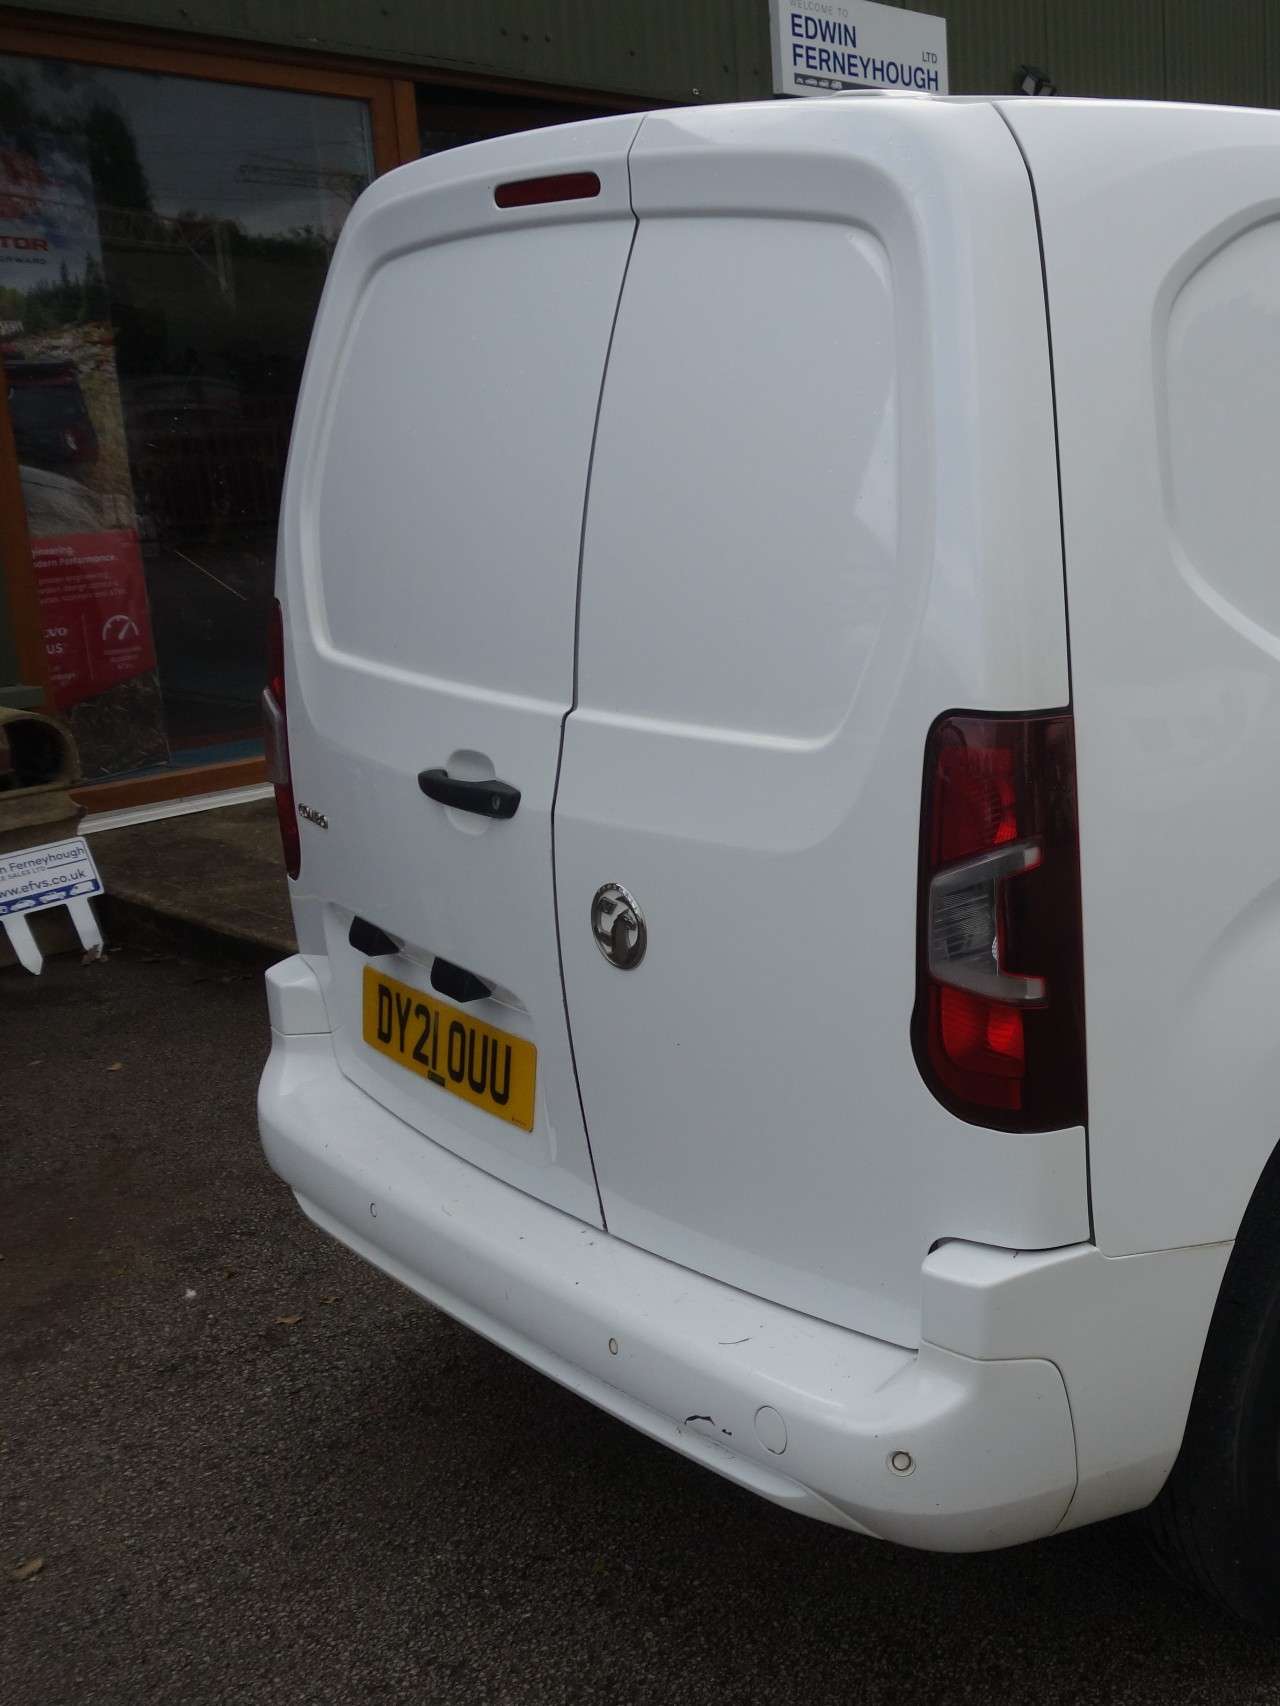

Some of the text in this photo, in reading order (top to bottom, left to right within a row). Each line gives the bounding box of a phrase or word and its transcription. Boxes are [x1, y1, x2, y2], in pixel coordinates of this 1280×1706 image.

[791, 13, 857, 48] EDWIN
[792, 43, 939, 91] FERNEYHOUGH
[921, 51, 938, 64] LTD
[9, 847, 85, 871] Ferneyhough
[377, 983, 513, 1107] DY21 OUU
